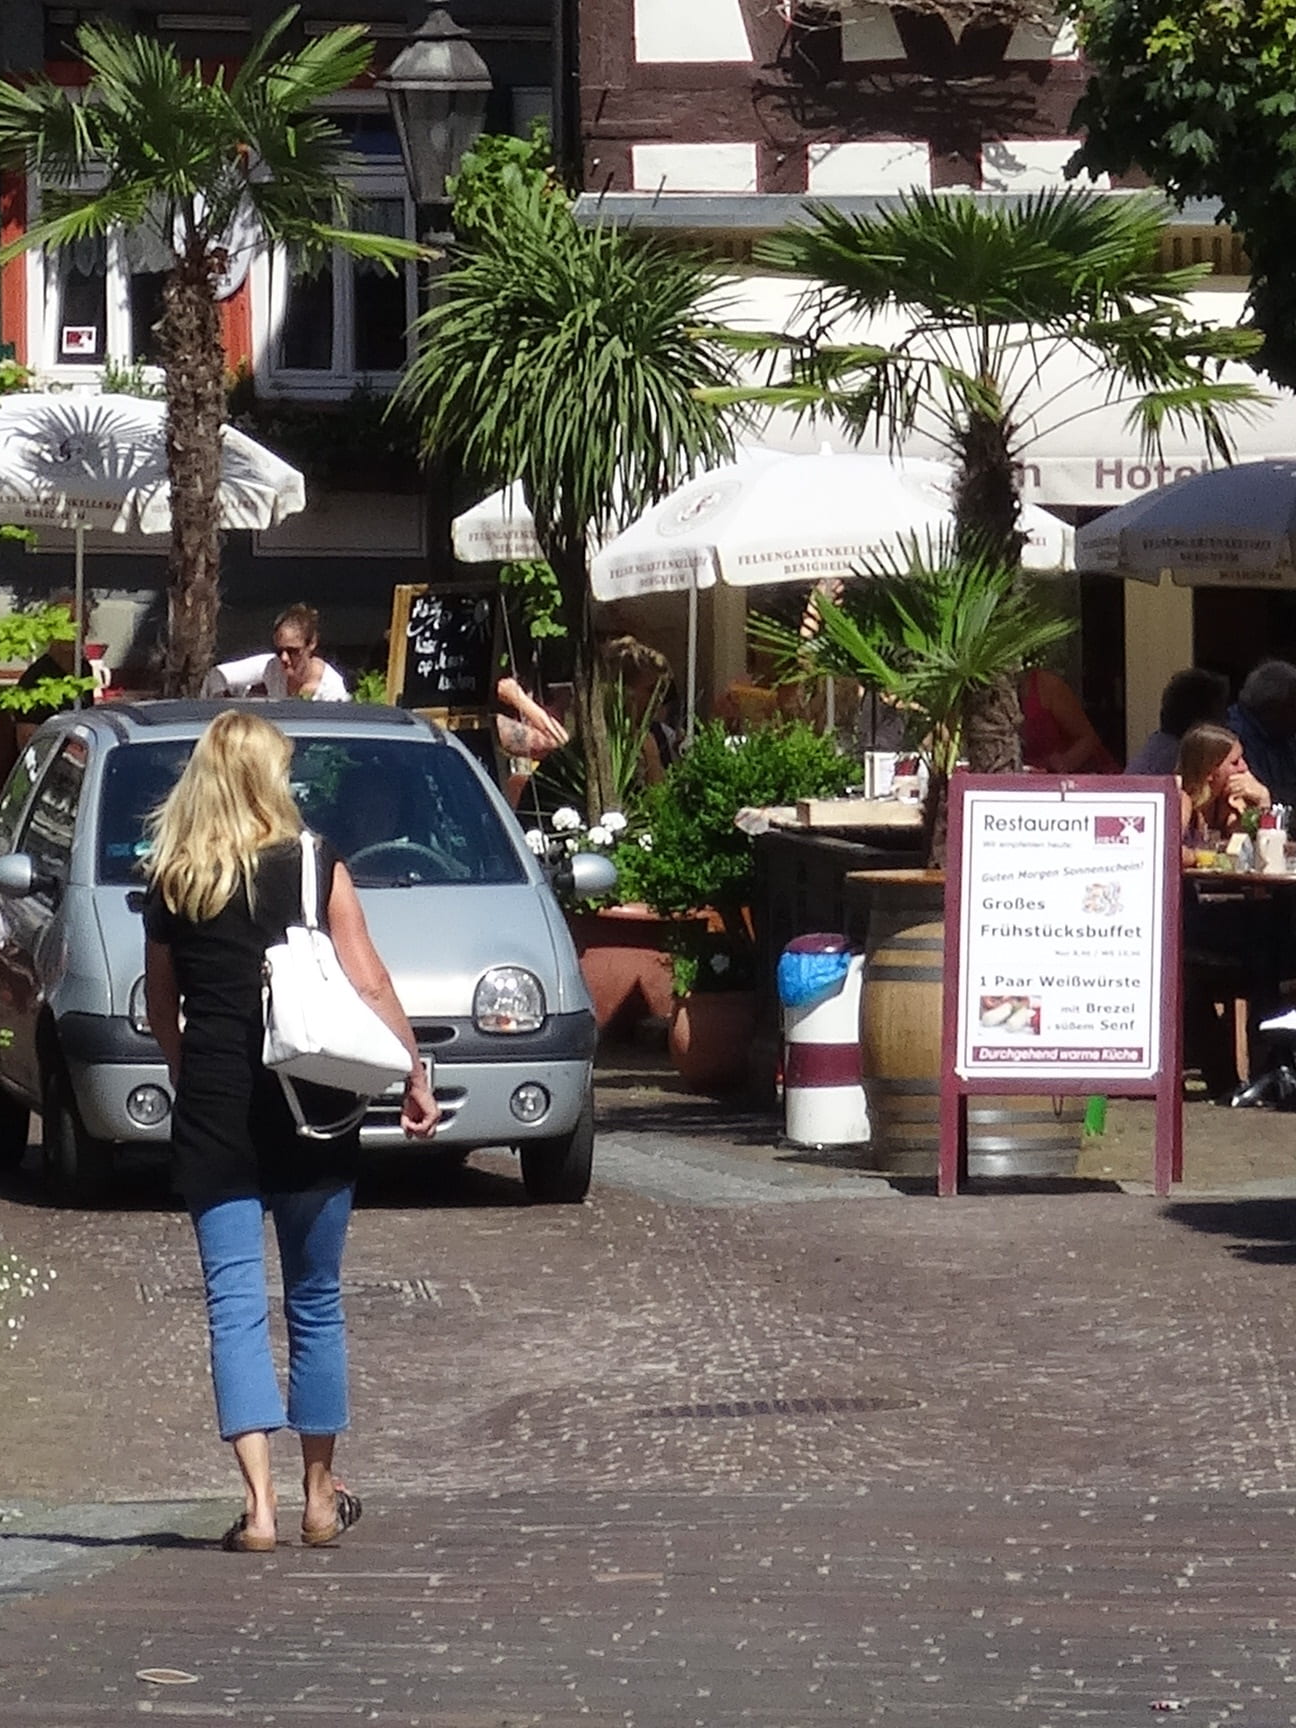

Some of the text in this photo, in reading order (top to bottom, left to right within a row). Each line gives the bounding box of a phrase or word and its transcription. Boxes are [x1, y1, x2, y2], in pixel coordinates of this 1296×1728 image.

[984, 814, 1090, 833] Restaurant
[982, 896, 1046, 911] Großes
[980, 924, 1143, 939] Frühstücksbuffet
[979, 974, 1141, 989] 1 Paar Weißwürste
[1086, 1003, 1136, 1015] Brezel
[1100, 1019, 1136, 1032] Senf
